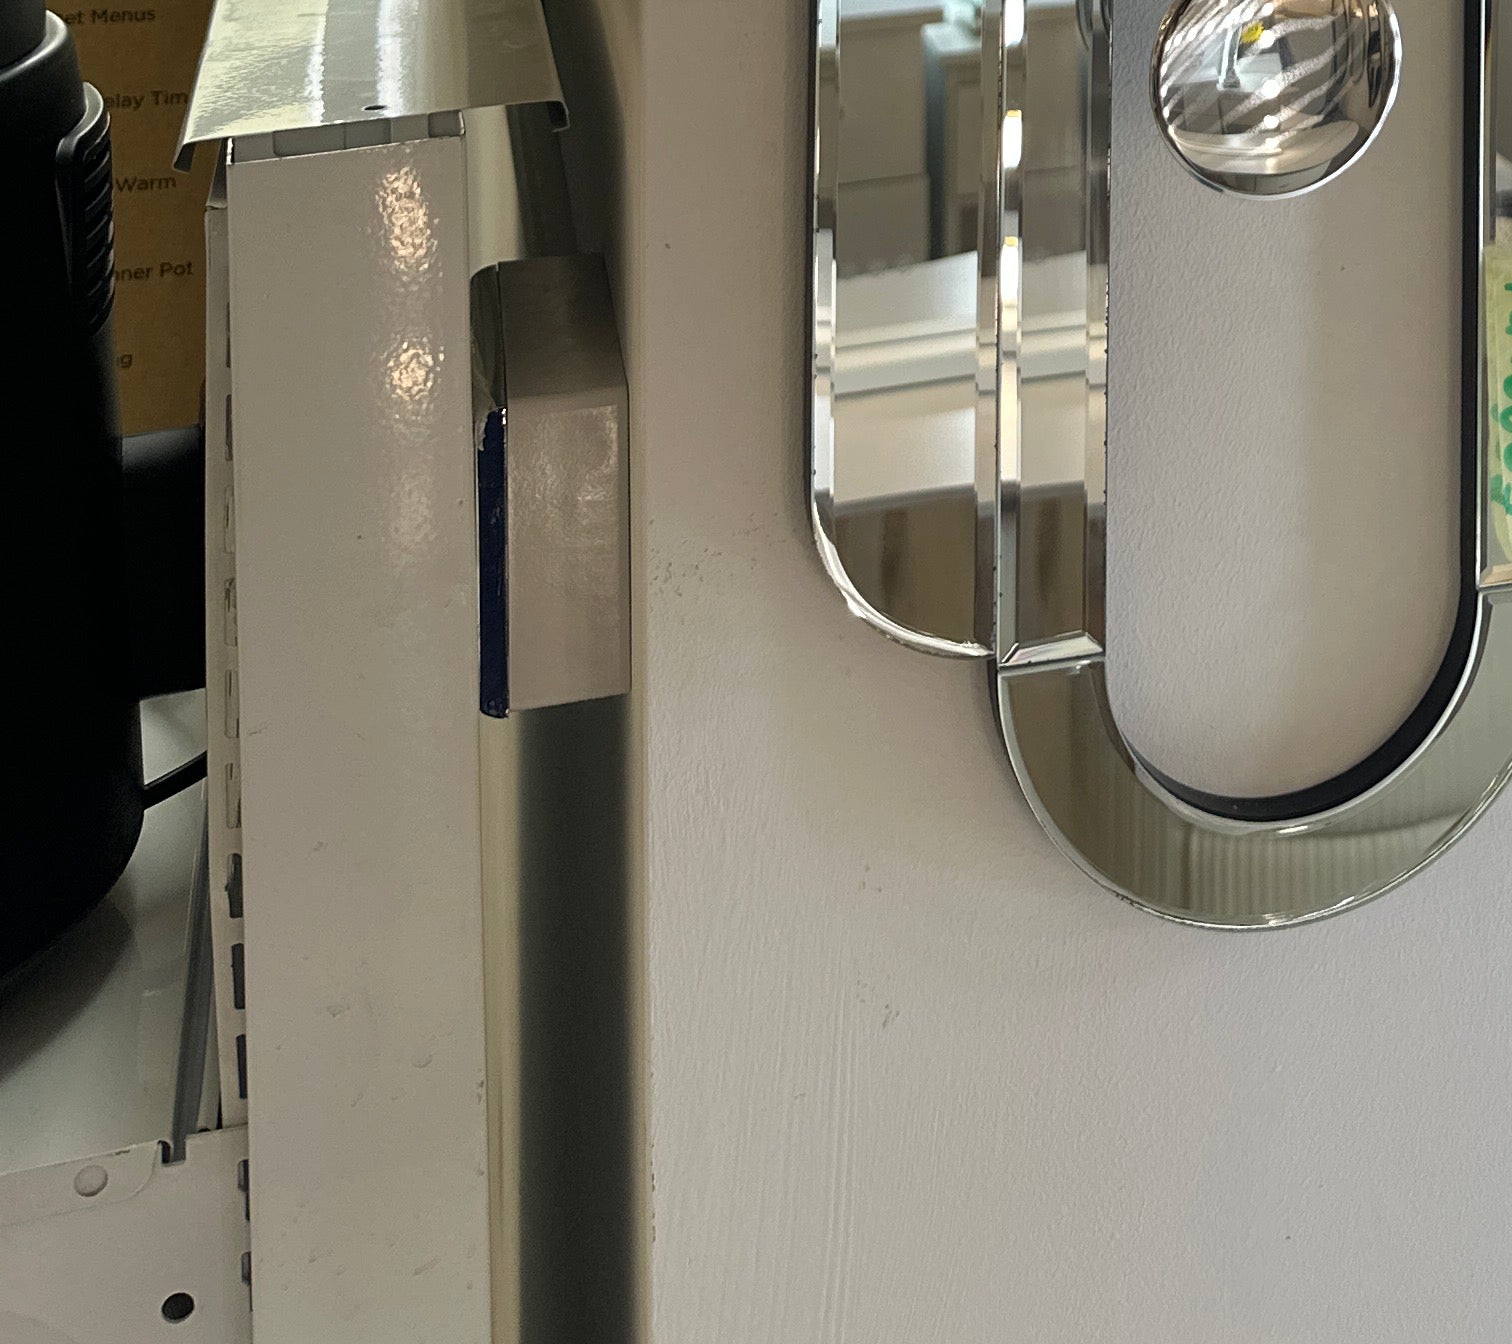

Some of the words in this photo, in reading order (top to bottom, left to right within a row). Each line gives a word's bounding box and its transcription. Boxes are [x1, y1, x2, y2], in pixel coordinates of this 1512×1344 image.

[92, 8, 157, 25] Menus
[104, 93, 145, 112] elay
[149, 89, 188, 107] Tim
[116, 174, 177, 194] Warm
[160, 260, 194, 279] Pot
